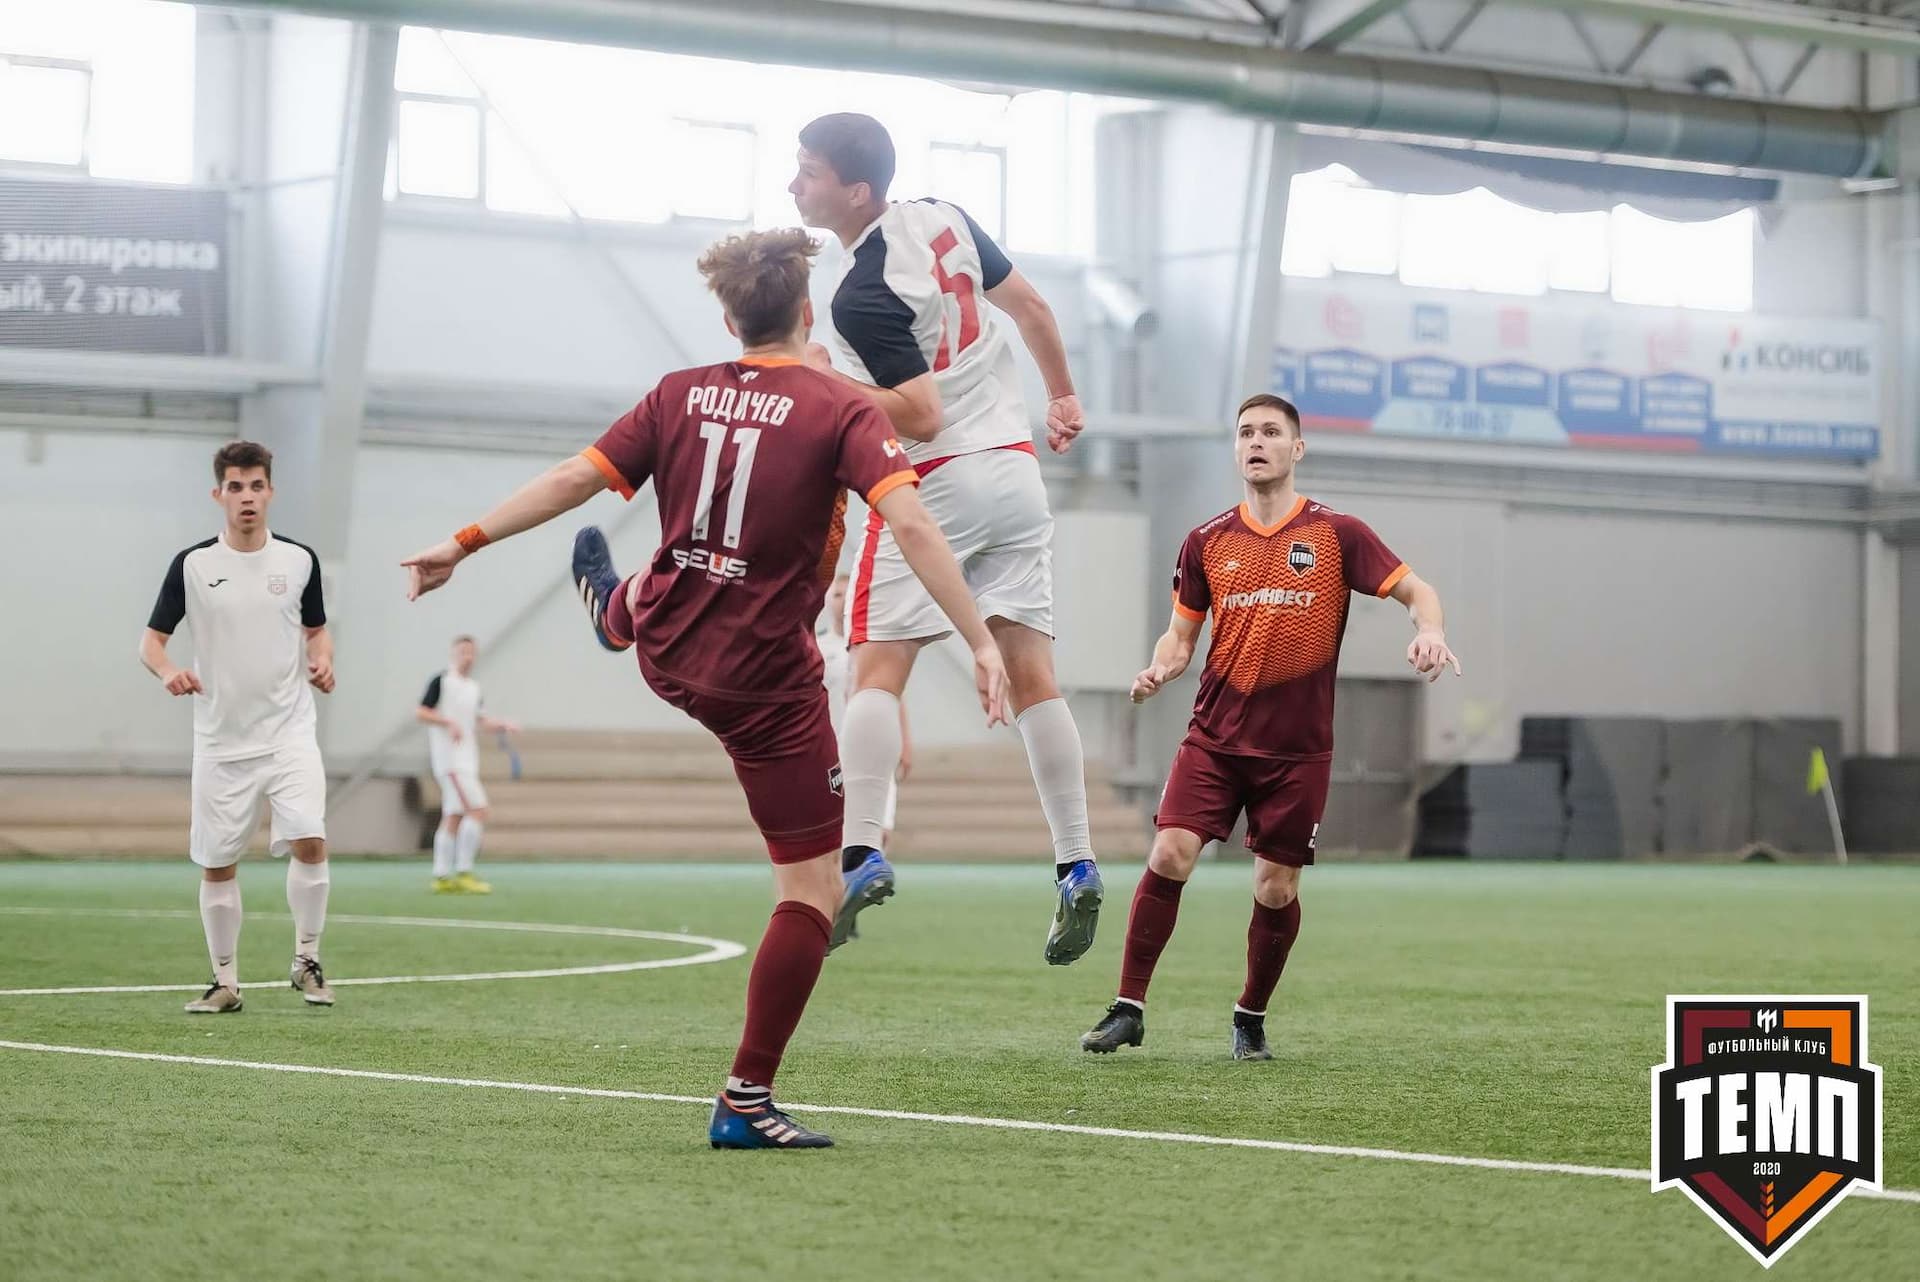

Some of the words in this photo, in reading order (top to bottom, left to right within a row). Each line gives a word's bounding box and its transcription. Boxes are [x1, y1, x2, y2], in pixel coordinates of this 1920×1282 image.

[2, 234, 219, 275] экипировка
[63, 275, 86, 314] 2
[95, 286, 183, 317] этаж
[686, 385, 795, 427] РОДИЧЕВ
[691, 421, 762, 549] 11
[672, 548, 749, 578] SEUS
